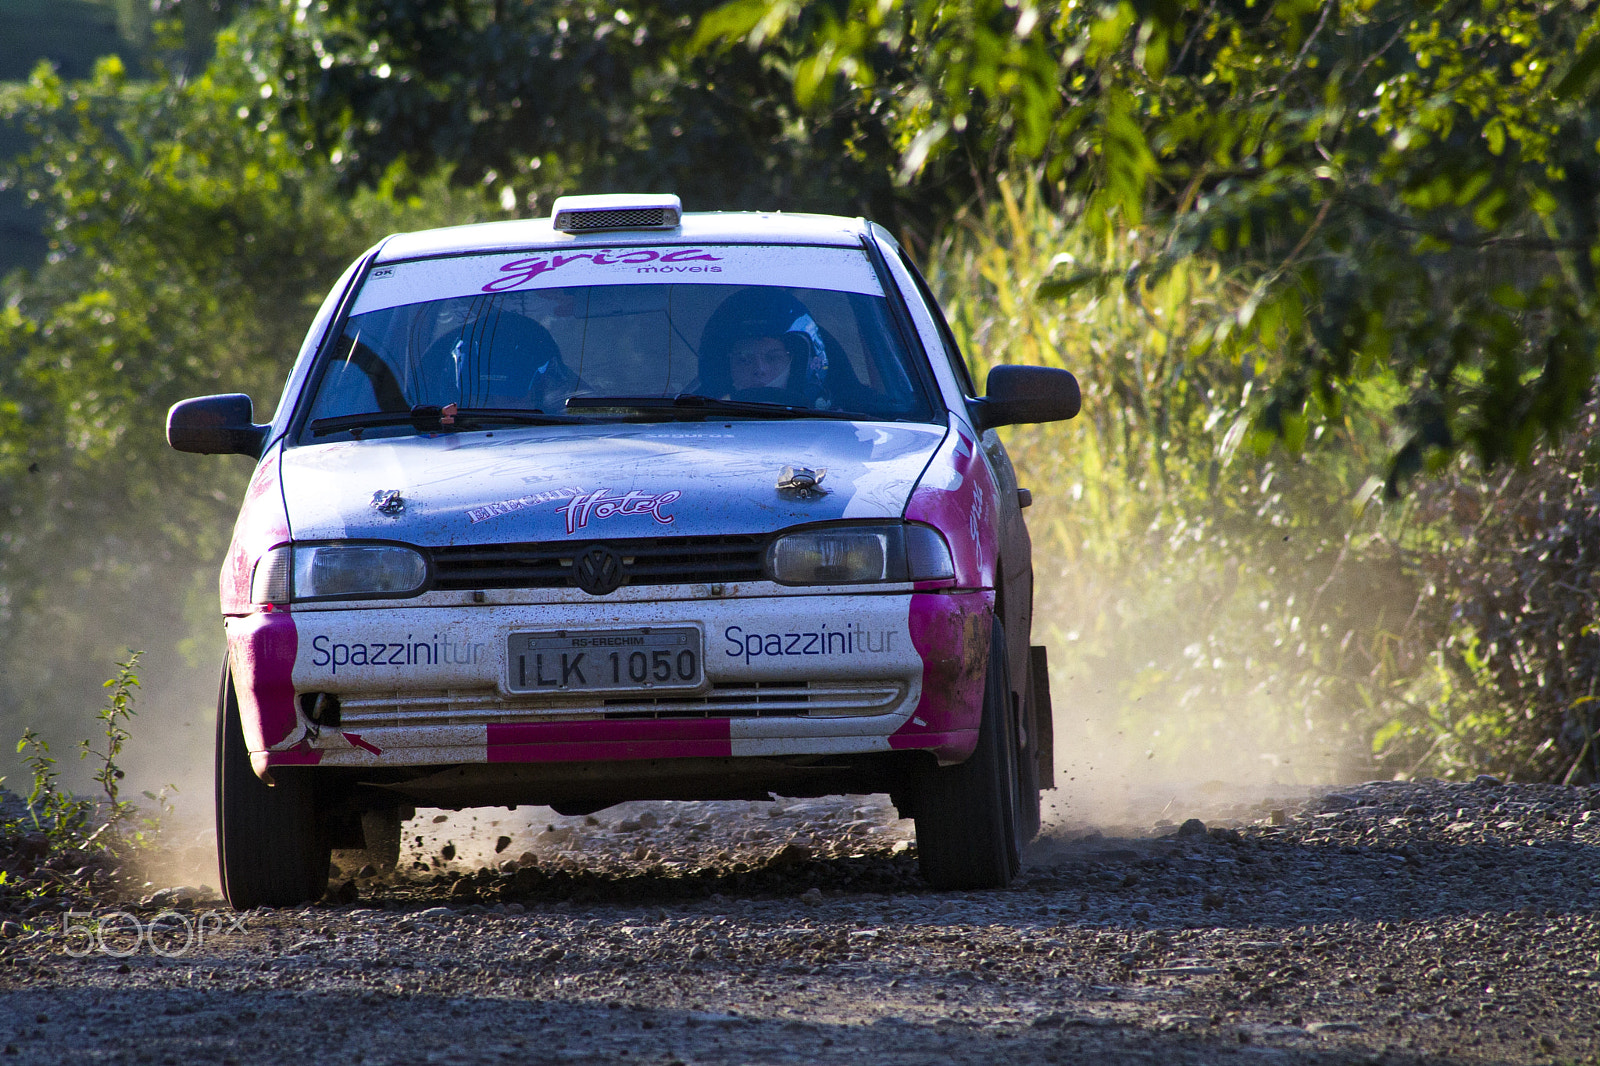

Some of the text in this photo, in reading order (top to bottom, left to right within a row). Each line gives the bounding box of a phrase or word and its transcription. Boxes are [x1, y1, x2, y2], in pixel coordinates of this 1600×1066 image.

[374, 269, 393, 278] OK
[482, 247, 724, 293] grisa
[637, 261, 723, 275] móveis
[555, 488, 683, 535] Hotel
[571, 635, 645, 648] RS-ERECHIM
[518, 648, 697, 688] ILK 1050
